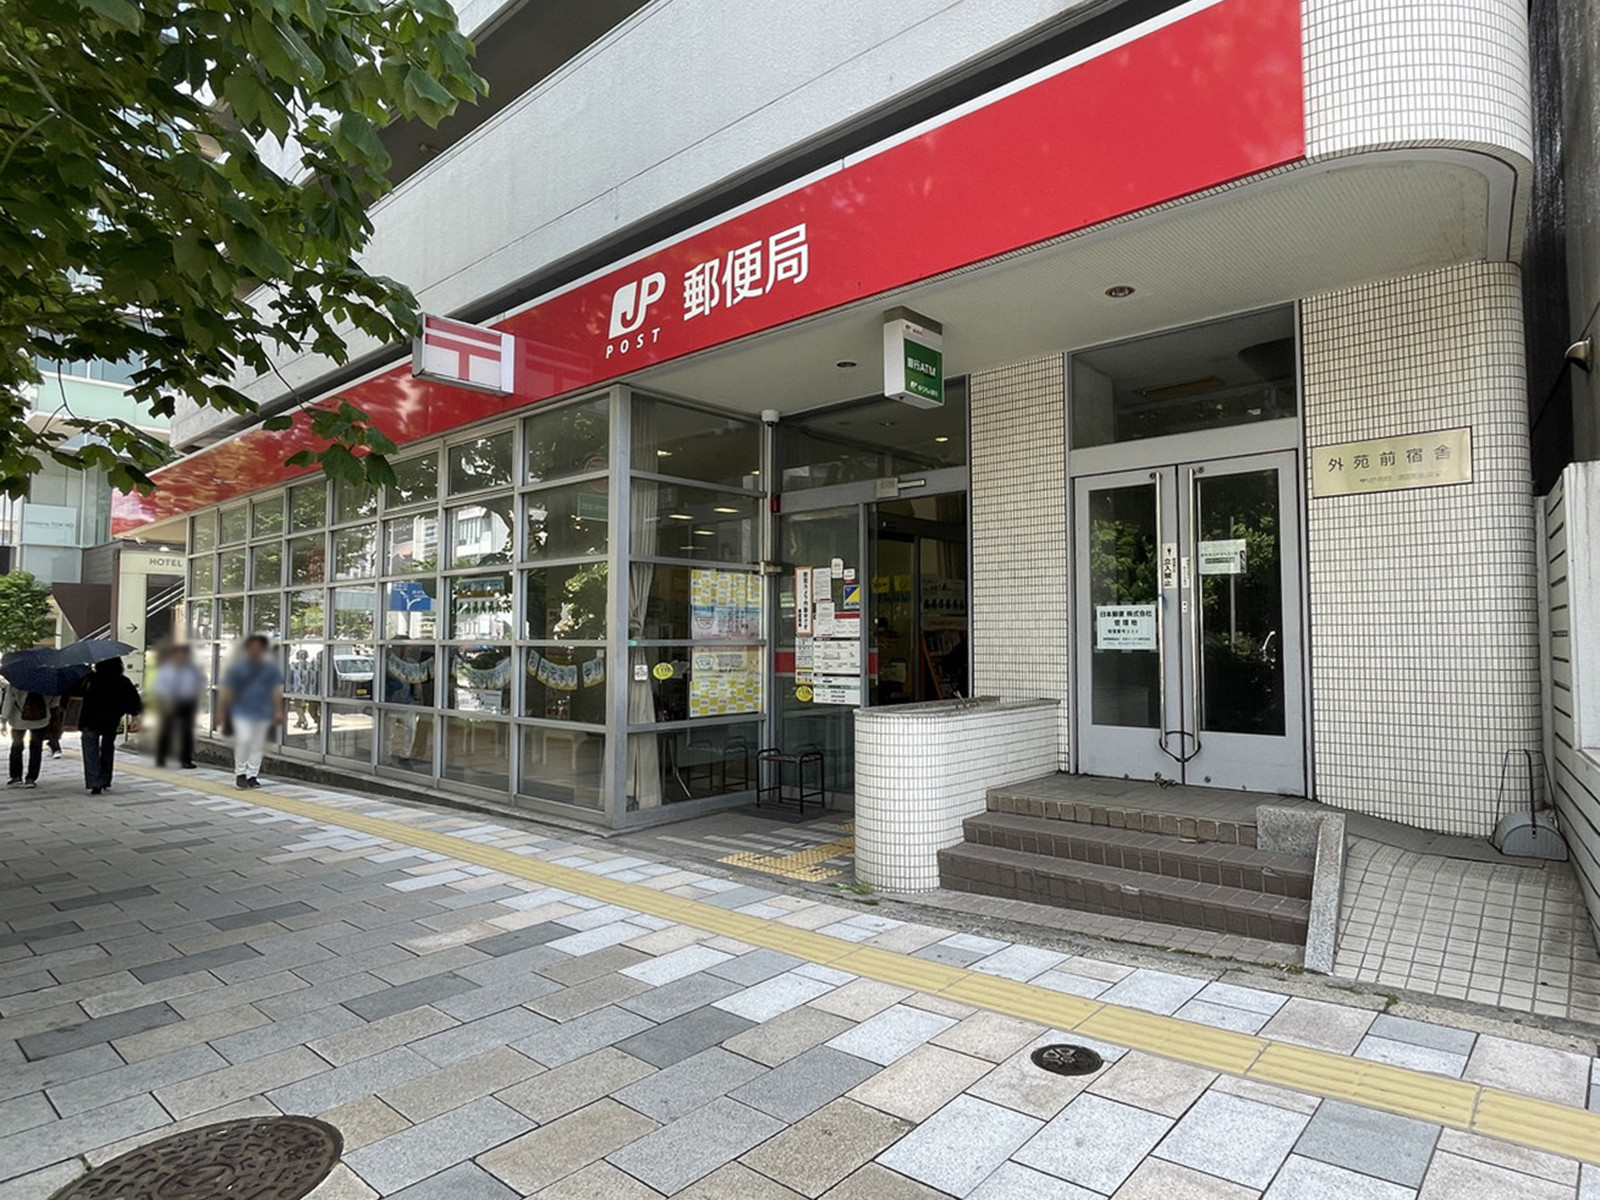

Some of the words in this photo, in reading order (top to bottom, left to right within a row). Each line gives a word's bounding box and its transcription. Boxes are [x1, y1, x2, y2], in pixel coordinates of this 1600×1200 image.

[683, 222, 809, 321] 郵便局
[605, 327, 662, 359] POST
[1327, 443, 1451, 473] 外苑前宿舎
[149, 557, 183, 567] HOTEL
[1163, 558, 1172, 587] 立入禁止
